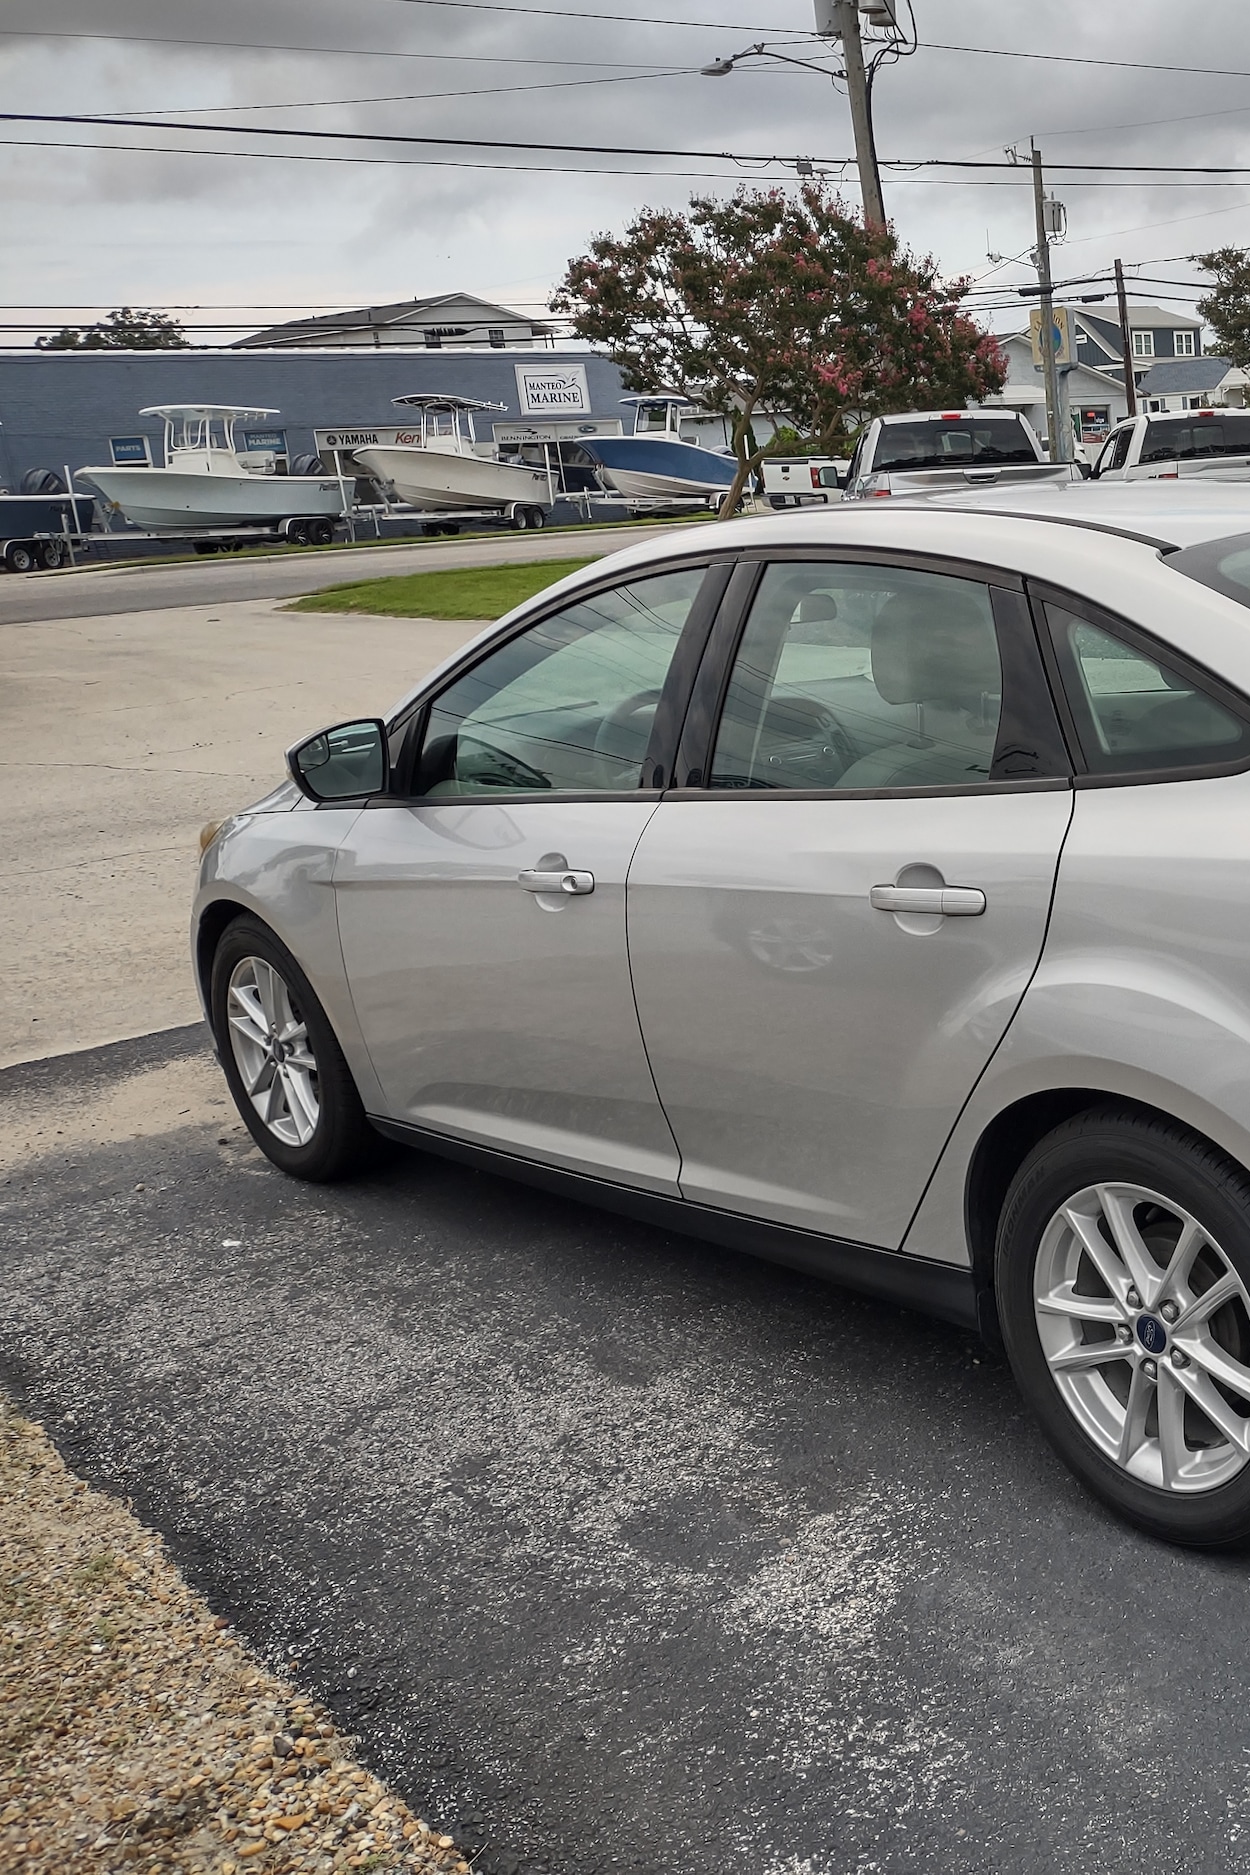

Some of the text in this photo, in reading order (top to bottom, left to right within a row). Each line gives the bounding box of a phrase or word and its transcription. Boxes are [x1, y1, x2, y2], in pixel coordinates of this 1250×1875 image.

[529, 382, 562, 390] MANTEO
[530, 392, 580, 403] MARINE
[249, 438, 281, 446] MARINE
[338, 434, 379, 445] YAMAHA
